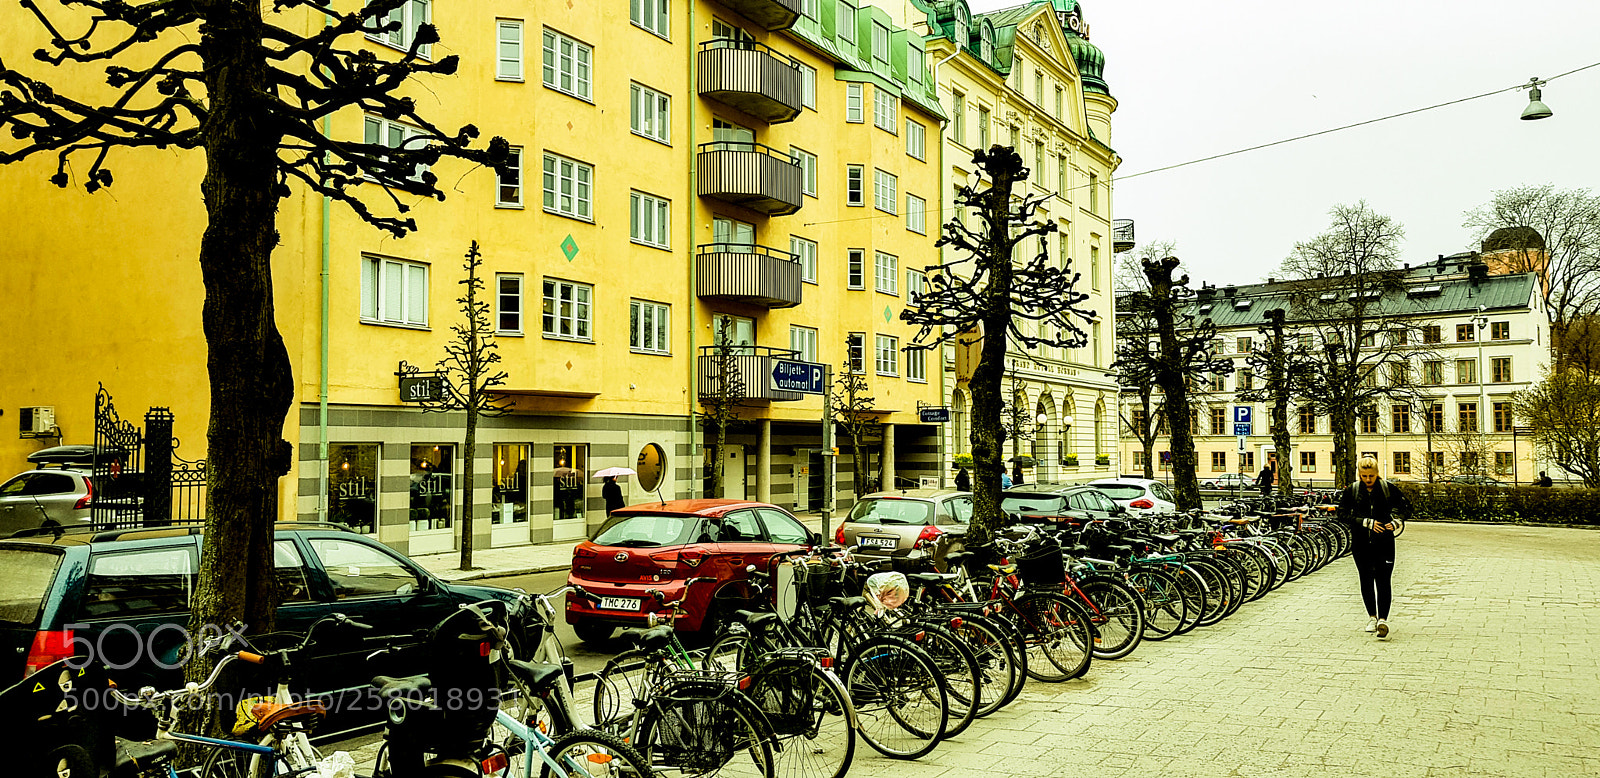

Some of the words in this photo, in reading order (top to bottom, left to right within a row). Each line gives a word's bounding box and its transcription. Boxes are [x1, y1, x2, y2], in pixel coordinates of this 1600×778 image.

[780, 363, 805, 377] Biljett-
[813, 368, 821, 389] P
[410, 379, 430, 397] stil
[779, 378, 808, 389] automat
[1238, 407, 1249, 421] P
[339, 476, 366, 497] stil
[419, 475, 443, 494] stil
[499, 471, 520, 490] stil
[559, 471, 578, 488] stil
[604, 598, 620, 608] TMC
[620, 599, 637, 609] 276
